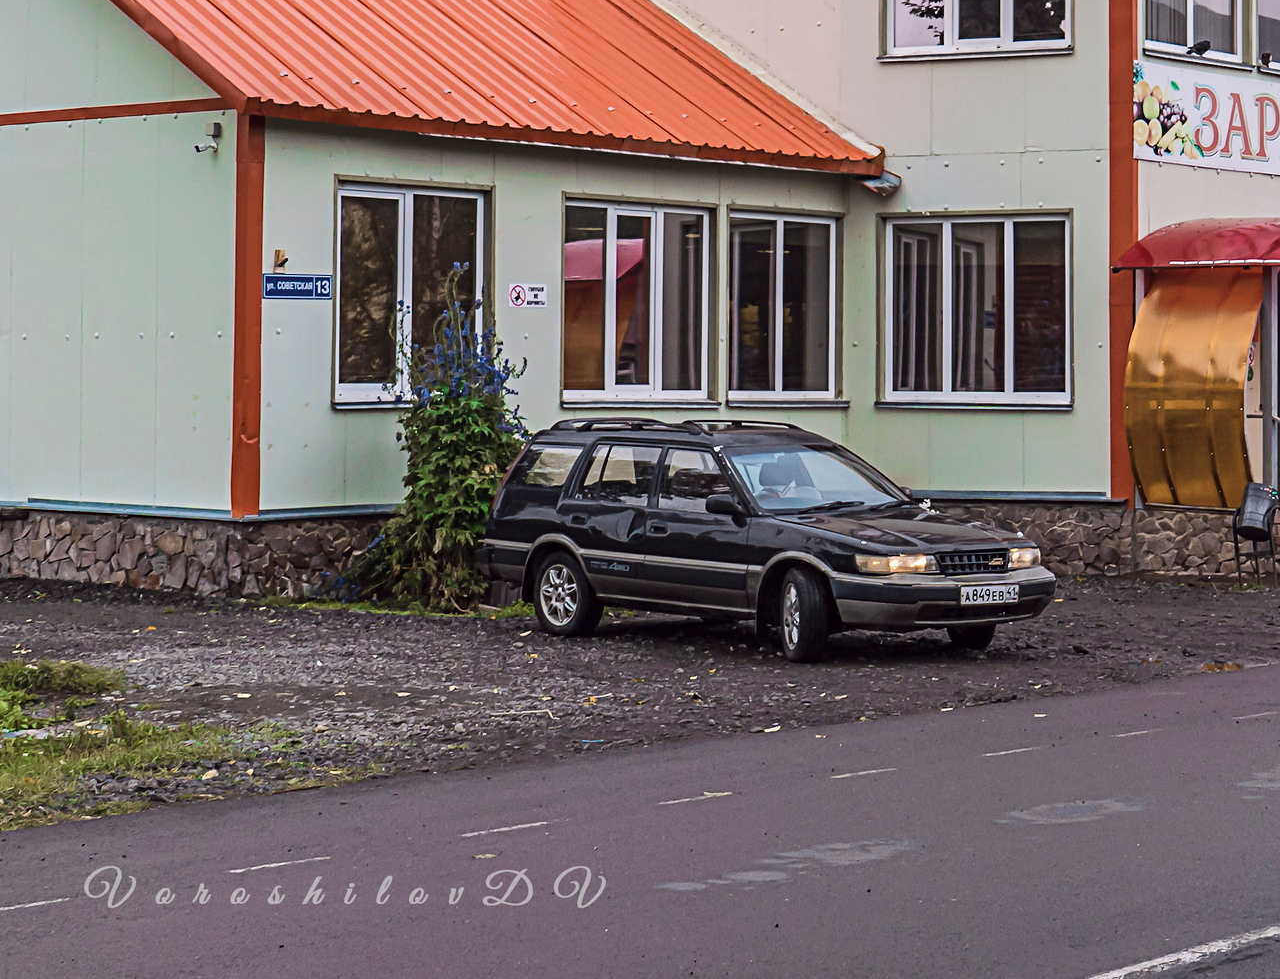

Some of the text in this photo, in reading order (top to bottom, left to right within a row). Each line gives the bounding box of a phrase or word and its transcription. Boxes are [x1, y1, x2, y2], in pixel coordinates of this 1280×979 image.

[266, 280, 330, 294] ул. СОВЕТСКАЯ 13
[1006, 586, 1017, 597] 41
